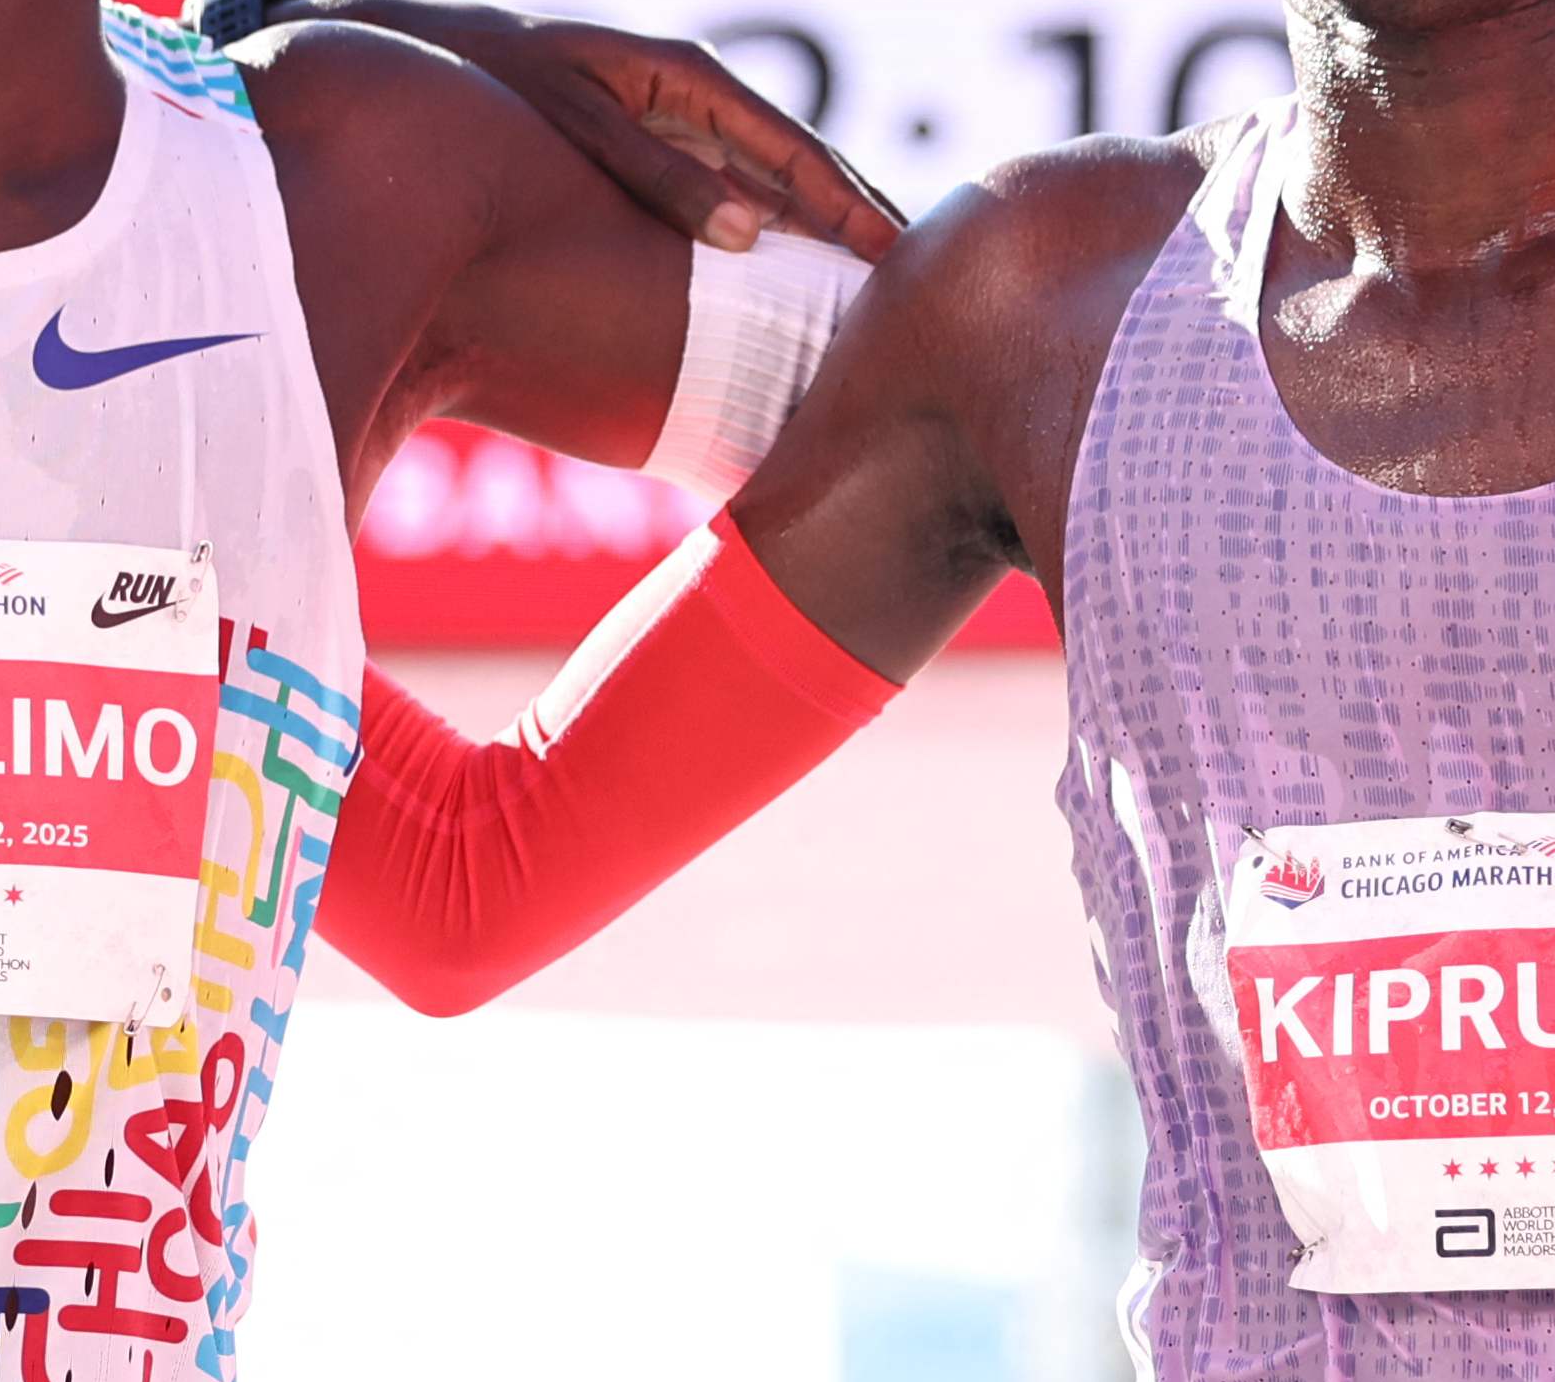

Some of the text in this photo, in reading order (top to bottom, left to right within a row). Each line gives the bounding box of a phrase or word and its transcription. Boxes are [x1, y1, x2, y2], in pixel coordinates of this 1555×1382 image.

[108, 570, 177, 606] RUN
[21, 820, 89, 848] 2025
[1342, 843, 1525, 870] BANK OF AMERICA
[1340, 871, 1444, 900] CHICAGO
[1368, 1091, 1508, 1120] OCTOBER
[1502, 1219, 1555, 1232] WORLD
